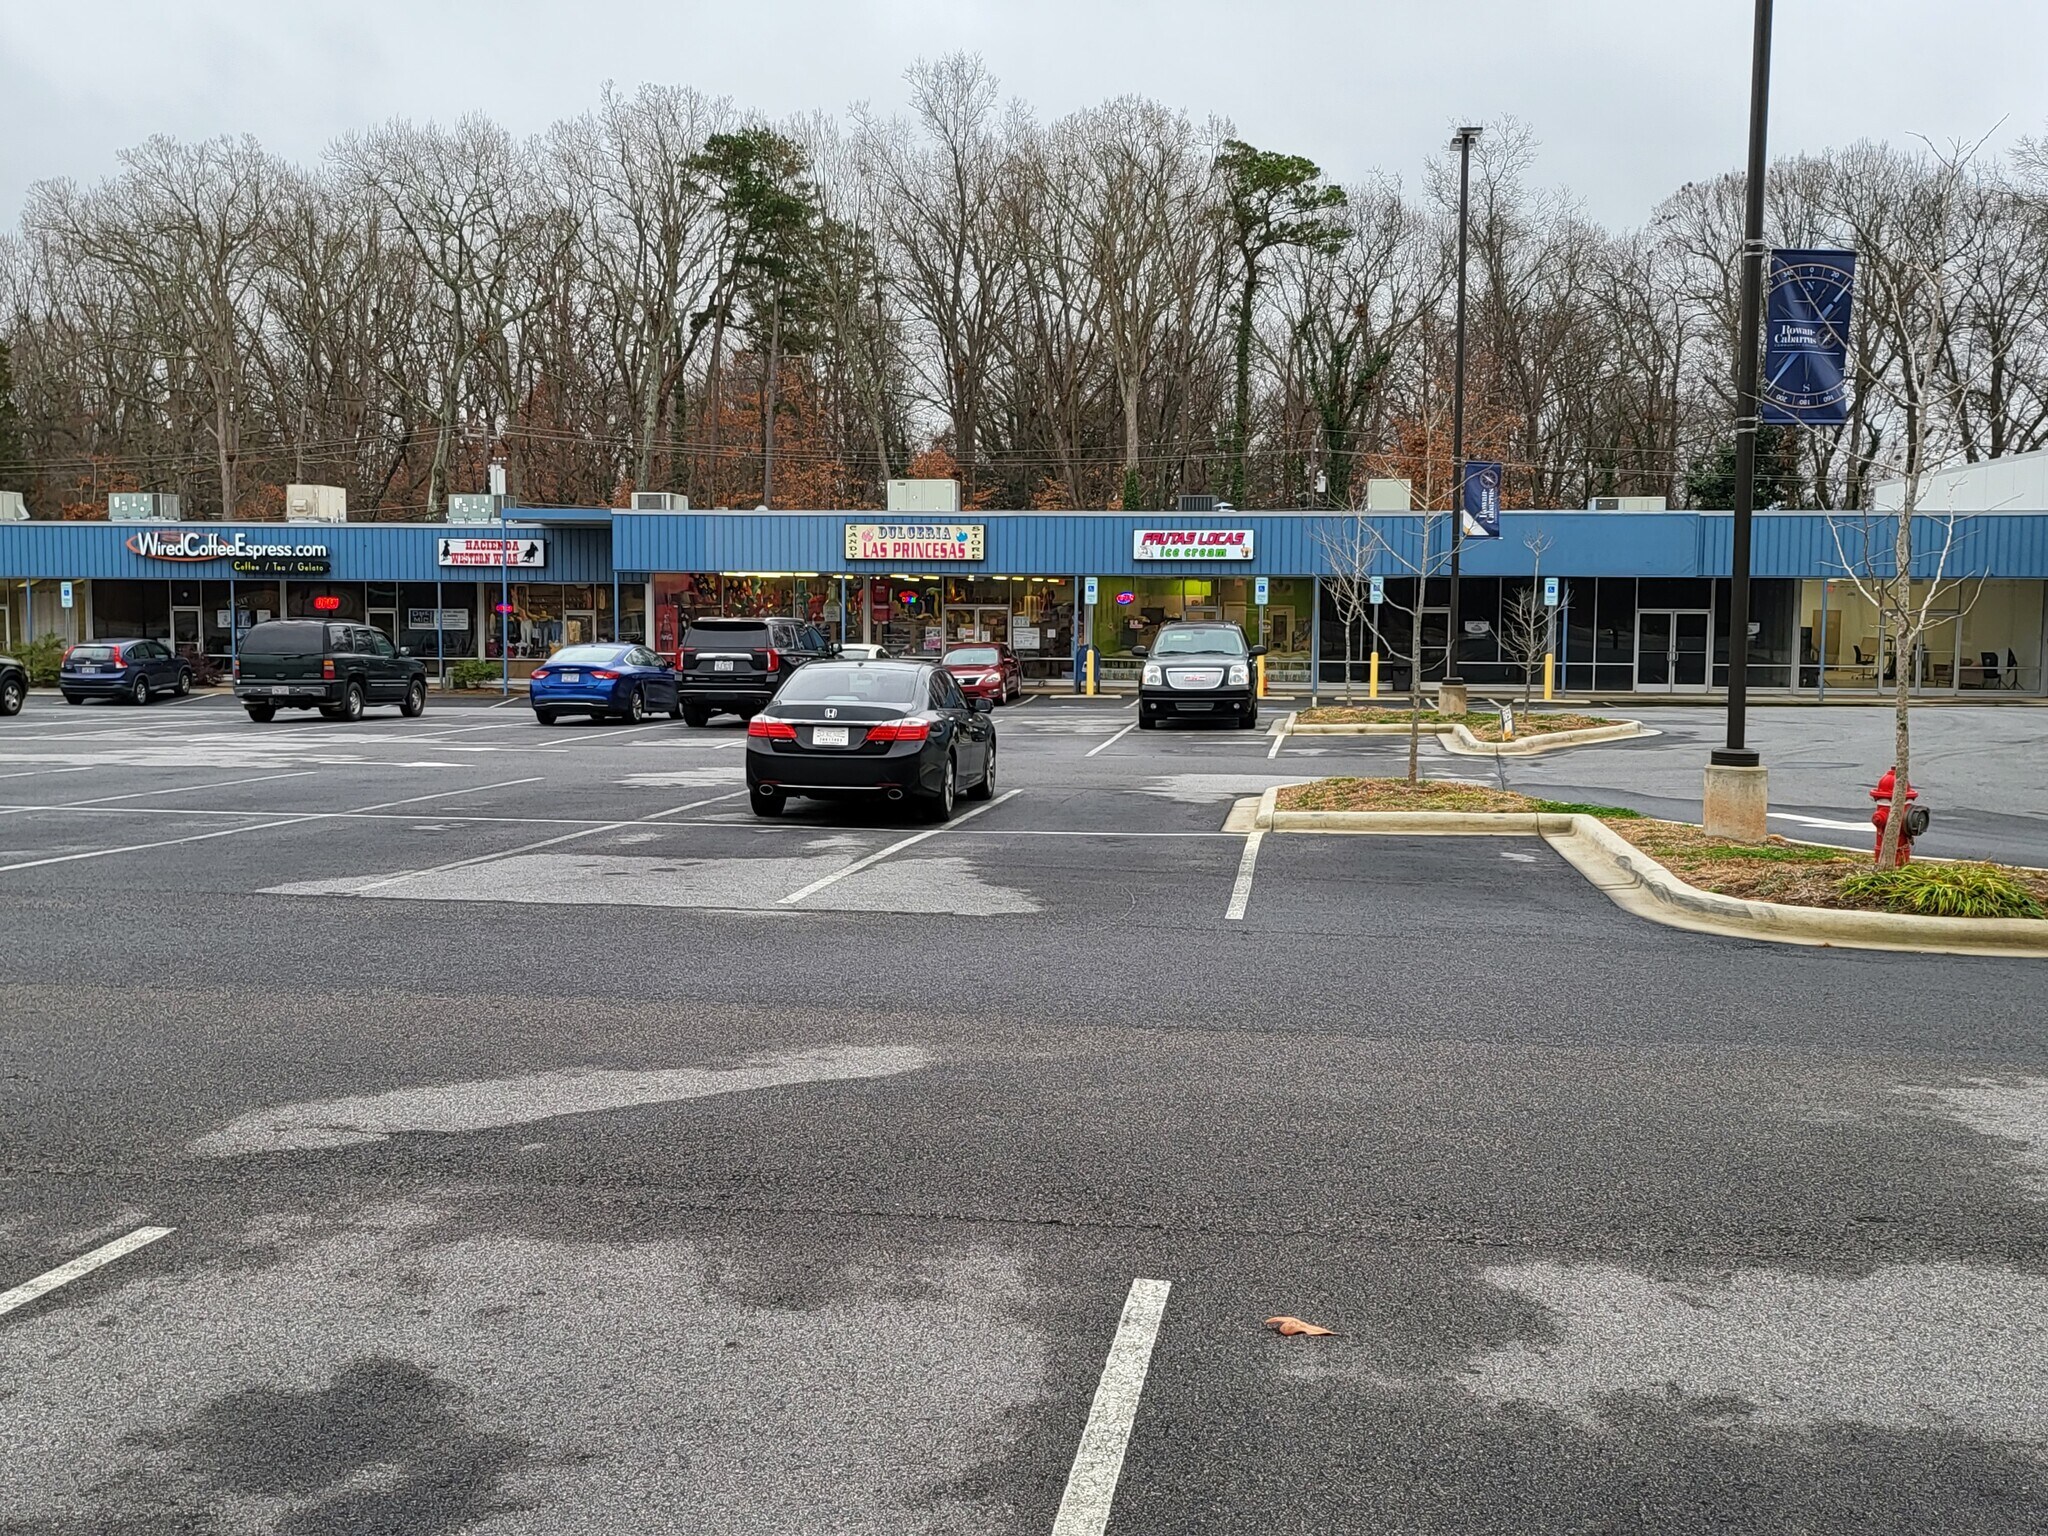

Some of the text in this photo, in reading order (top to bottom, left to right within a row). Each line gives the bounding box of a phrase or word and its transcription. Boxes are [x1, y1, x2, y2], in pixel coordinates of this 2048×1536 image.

[1782, 325, 1816, 336] Rowan-
[1774, 334, 1817, 344] Cabarrus
[877, 526, 952, 540] DULCERIA
[1142, 532, 1246, 546] FRUTAS LOCAS
[137, 531, 327, 559] WiredCoffeeEspress.com
[465, 540, 520, 551] HACIENDA
[848, 525, 858, 558] CANDY
[971, 526, 981, 559] STORE
[863, 542, 966, 559] LAS PRINCESAS
[1159, 545, 1228, 558] ice cream
[451, 553, 519, 565] WESTERN WAR
[233, 561, 260, 571] Coffee
[272, 562, 286, 571] Tea
[297, 562, 324, 572] Gelato
